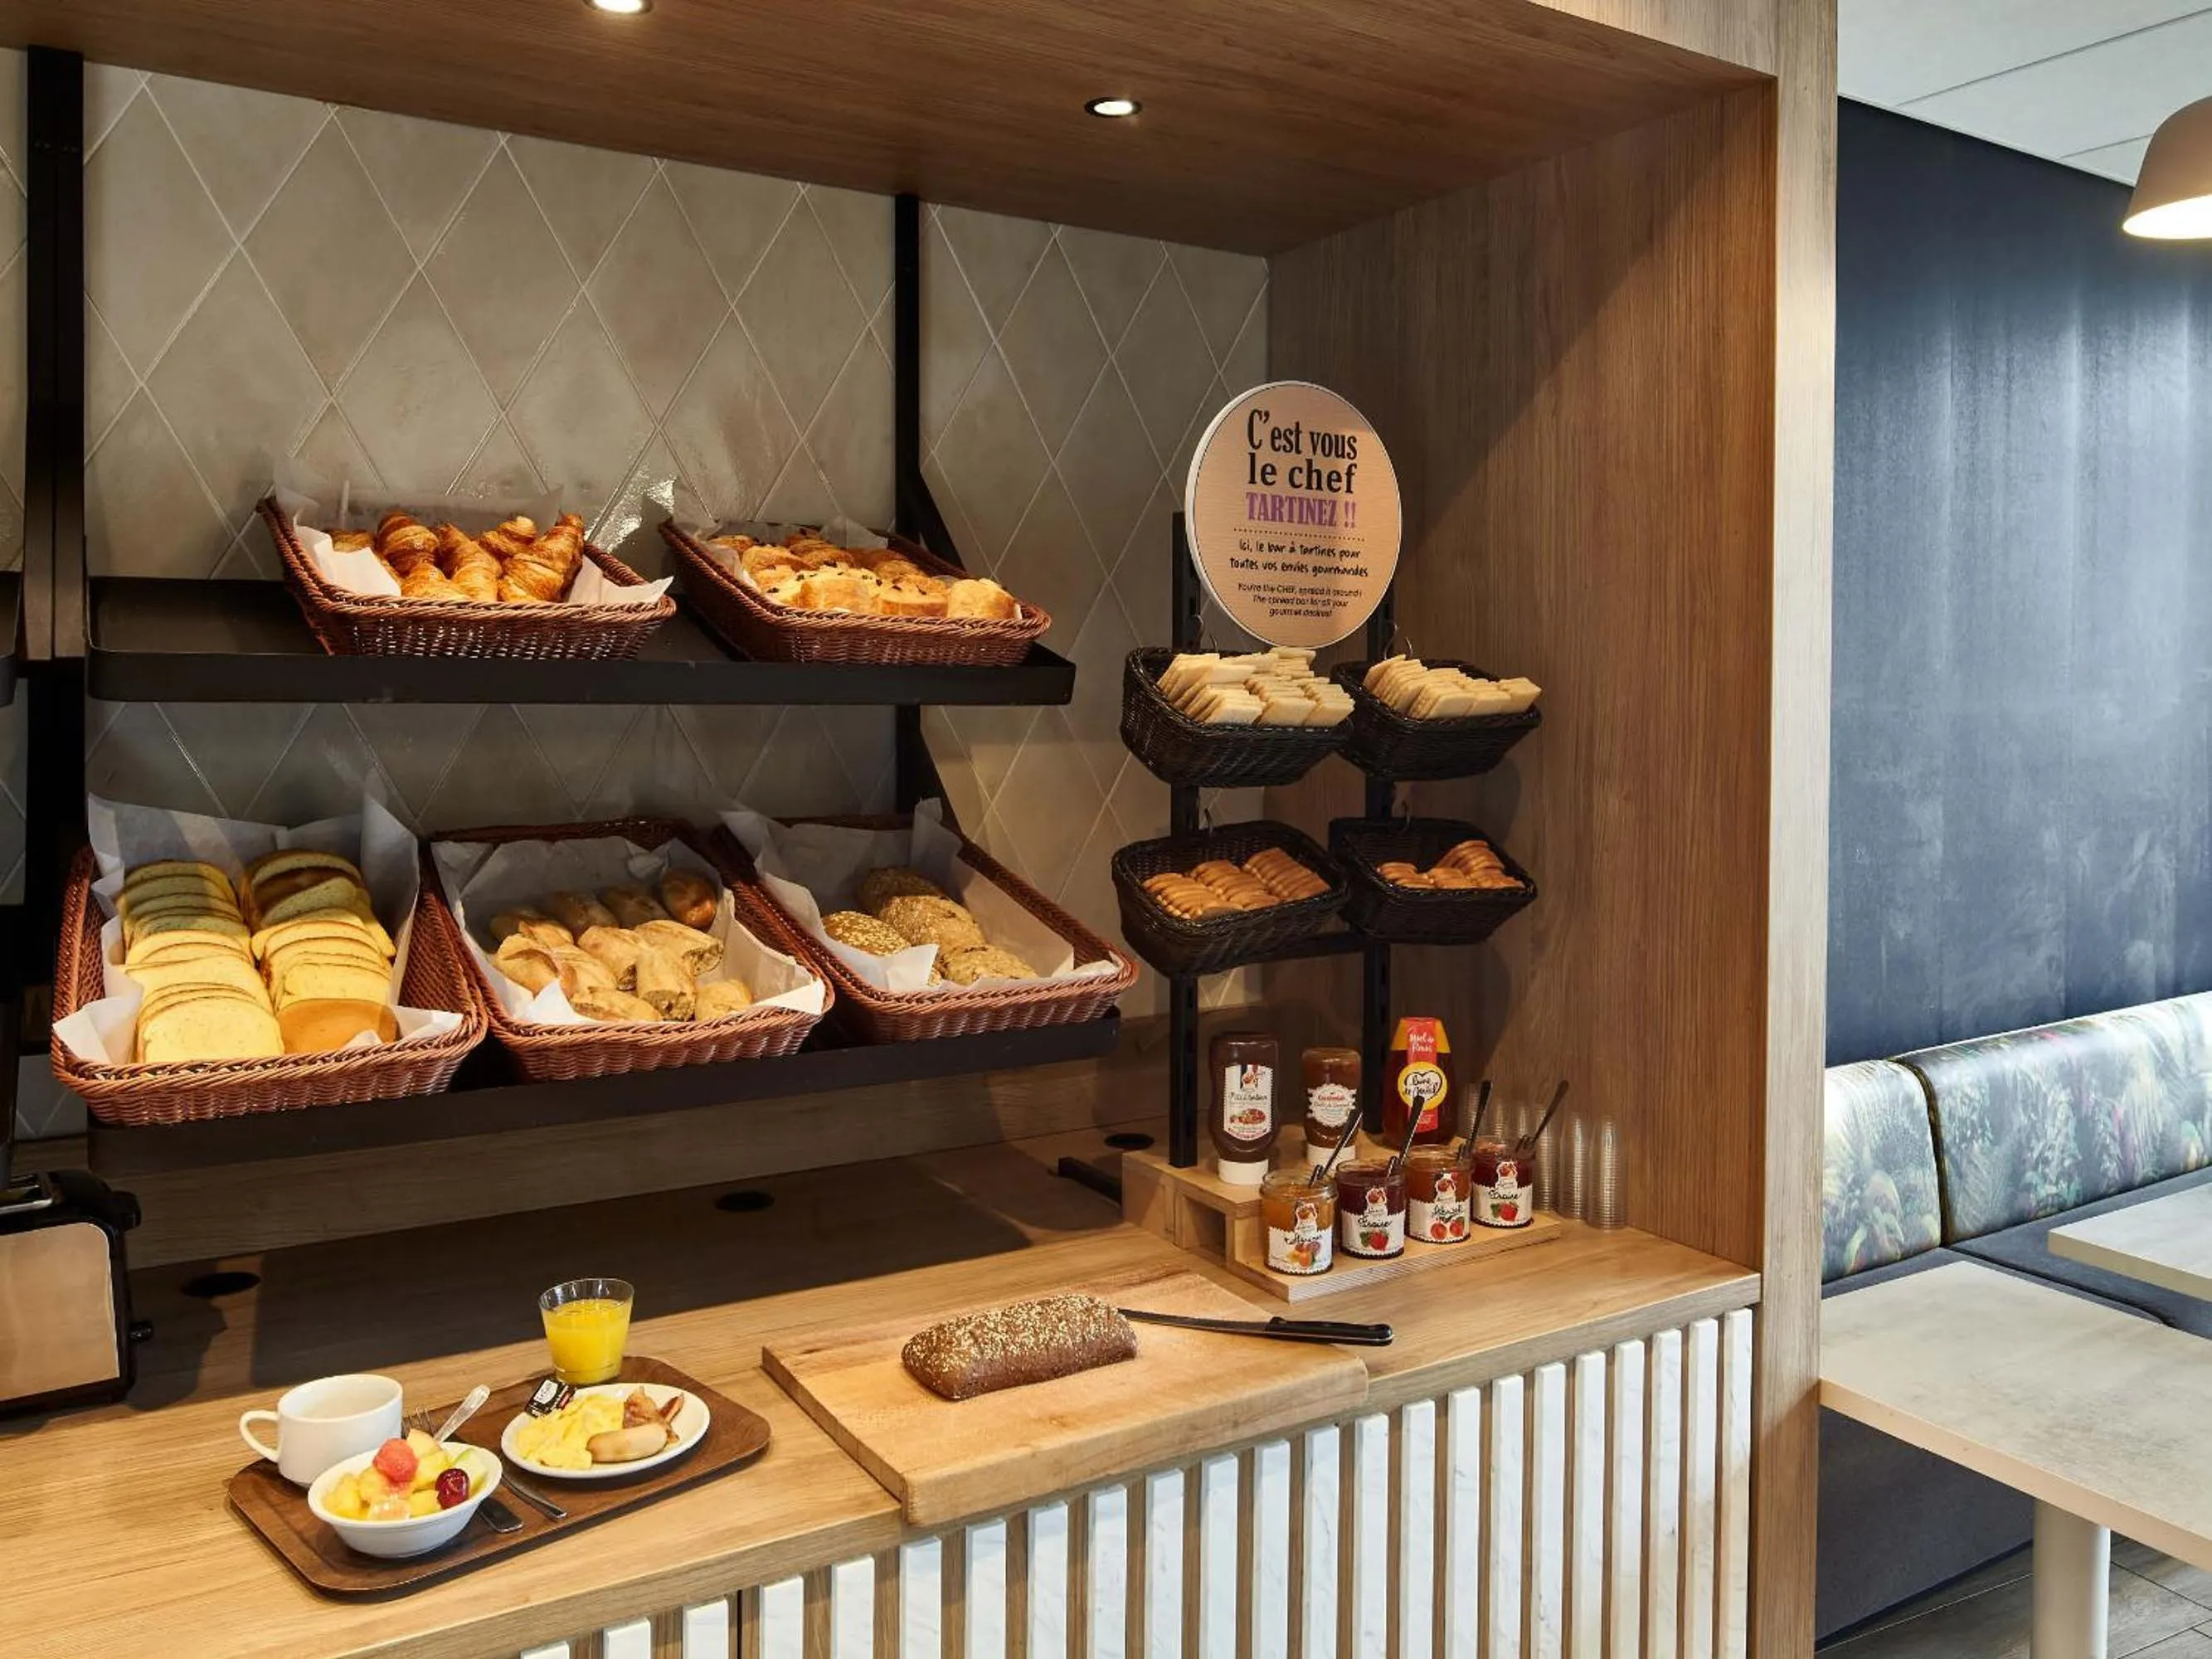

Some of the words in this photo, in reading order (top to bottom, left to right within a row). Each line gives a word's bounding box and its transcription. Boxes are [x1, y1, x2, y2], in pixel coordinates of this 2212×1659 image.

[1309, 431, 1358, 460] vous
[1247, 452, 1276, 486] le
[1288, 458, 1358, 494] chef
[1246, 491, 1337, 527] TARTINEZ
[1256, 540, 1264, 552] le
[1268, 542, 1285, 553] bar
[1289, 541, 1296, 553] à
[1299, 543, 1336, 558] tartines
[1339, 549, 1360, 562] pour
[1230, 557, 1259, 570] toutes
[1262, 562, 1278, 572] vos
[1281, 562, 1309, 573] envies
[1312, 564, 1369, 577] gourmandes
